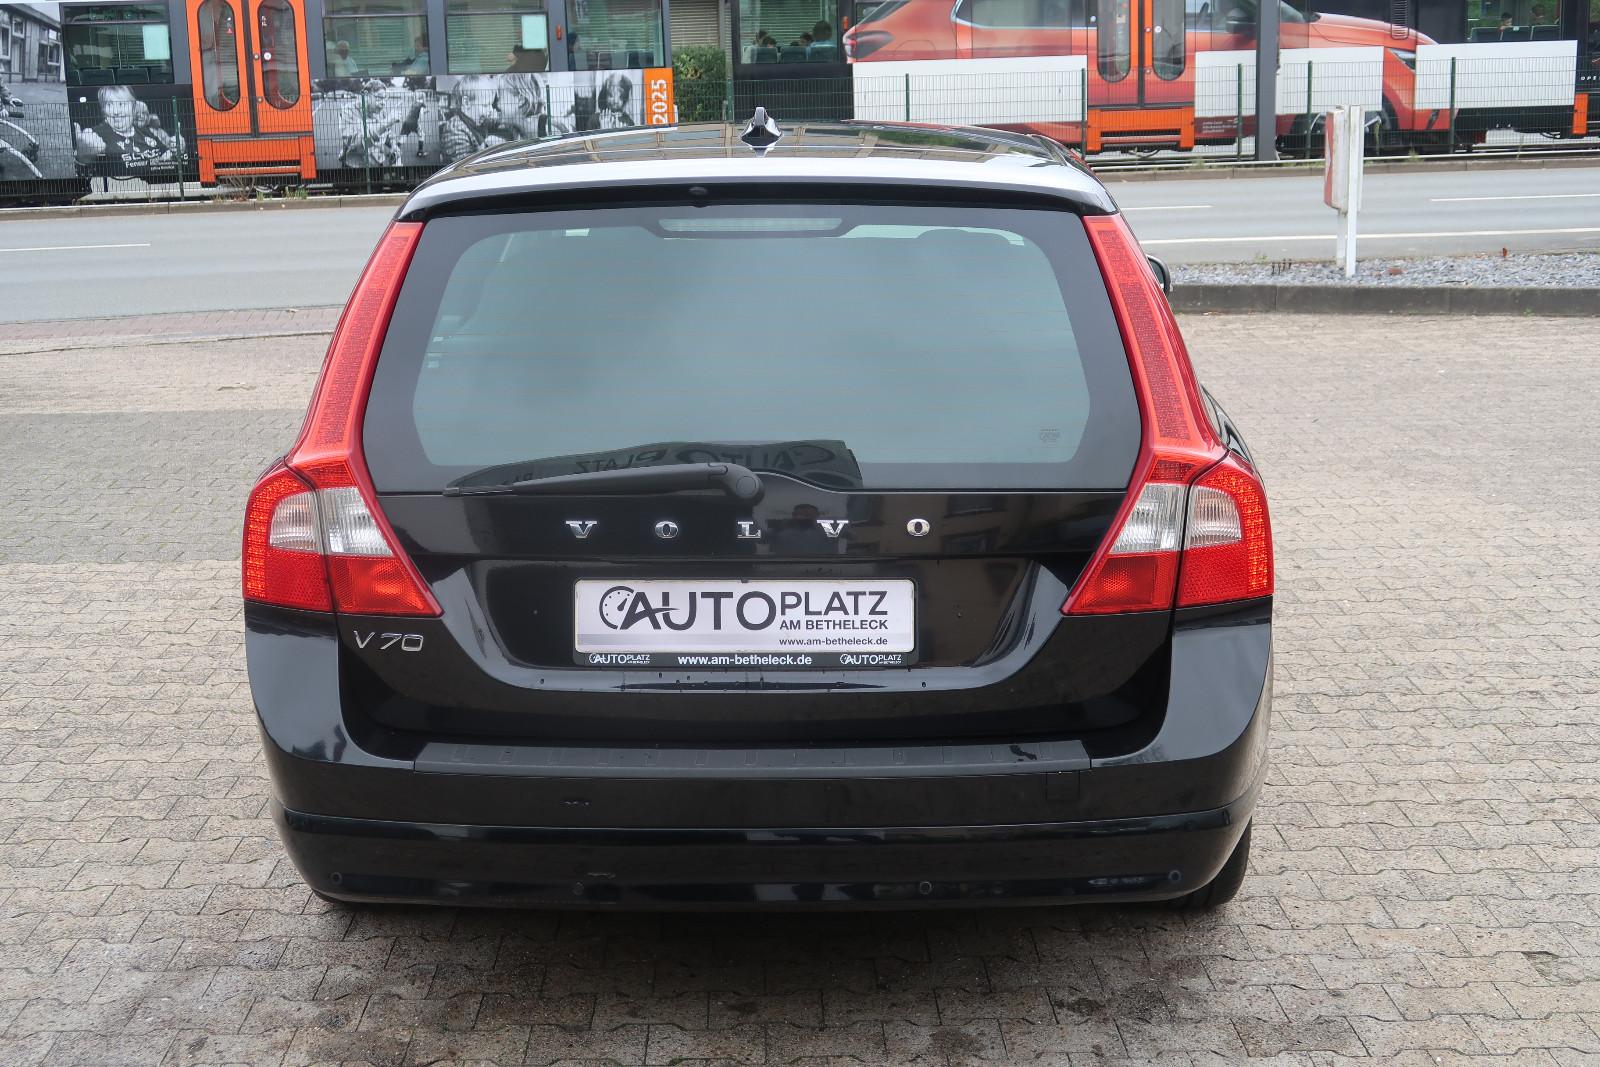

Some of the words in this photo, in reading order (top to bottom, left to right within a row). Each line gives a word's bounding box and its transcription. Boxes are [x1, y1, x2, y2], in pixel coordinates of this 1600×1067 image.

[651, 79, 668, 124] 2025
[565, 517, 931, 539] VOLVO
[779, 619, 800, 630] AM
[805, 619, 889, 630] BETHELECK
[779, 636, 889, 647] www.am-betheleck.de
[677, 653, 813, 666] www.am-betheleck.de
